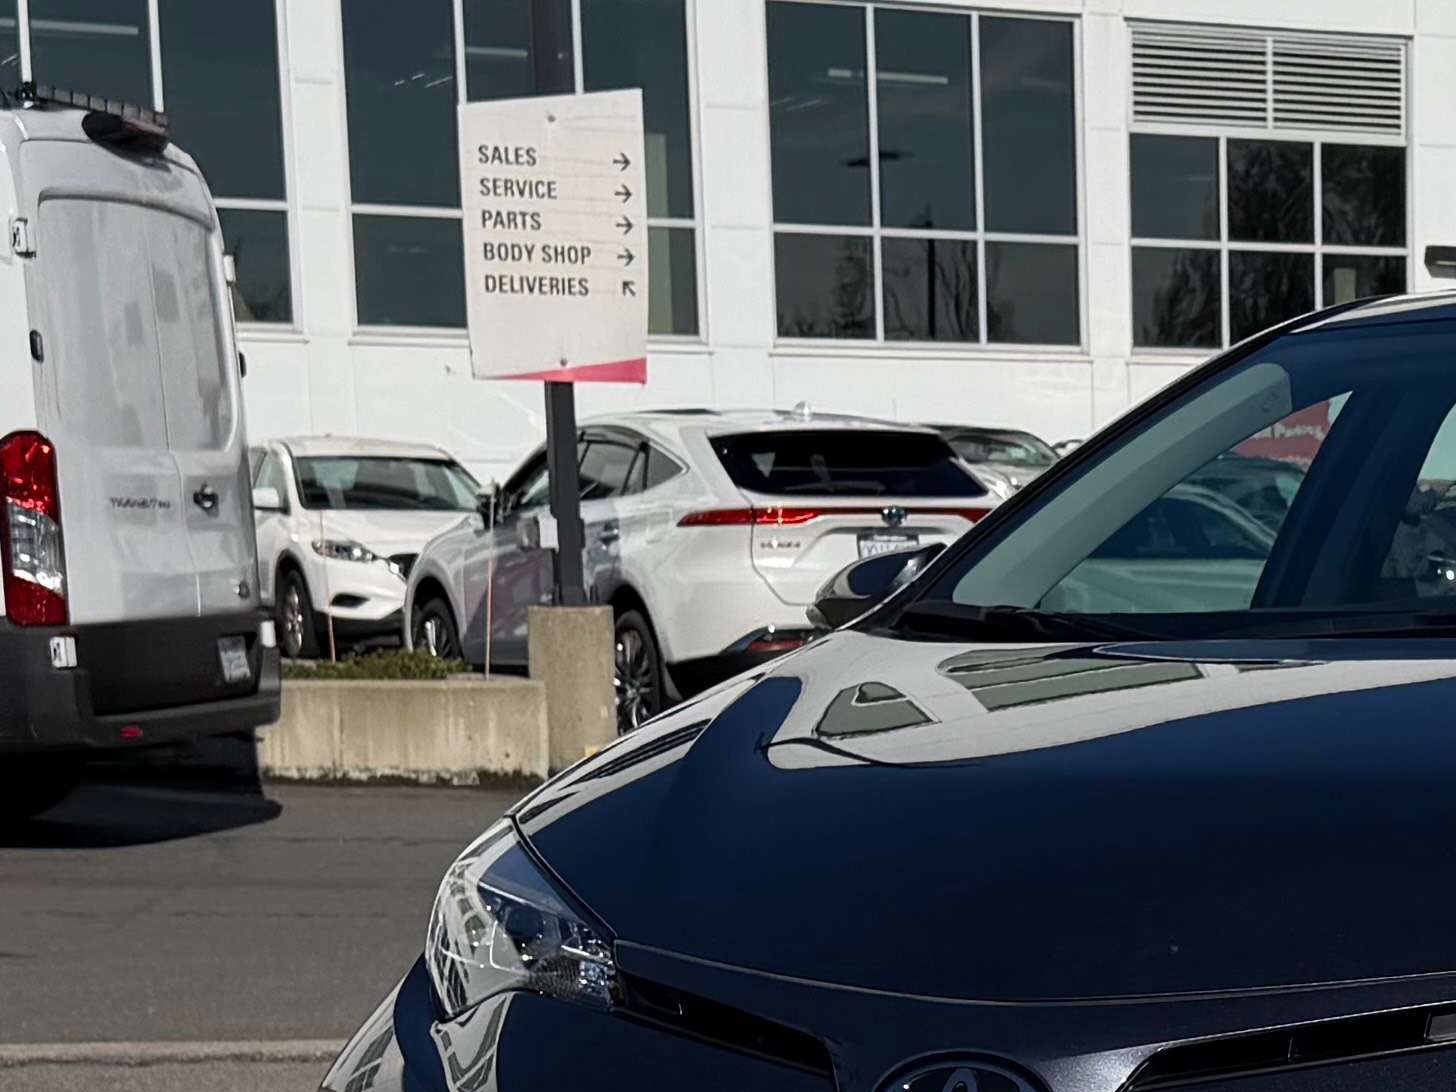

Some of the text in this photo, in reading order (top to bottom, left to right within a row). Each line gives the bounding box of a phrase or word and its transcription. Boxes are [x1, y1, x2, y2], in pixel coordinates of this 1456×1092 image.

[478, 144, 537, 167] SALES
[480, 177, 558, 200] SERVICE
[481, 209, 542, 231] PARTS
[483, 242, 592, 265] BODY SHOP
[484, 274, 590, 297] DELIVERIES
